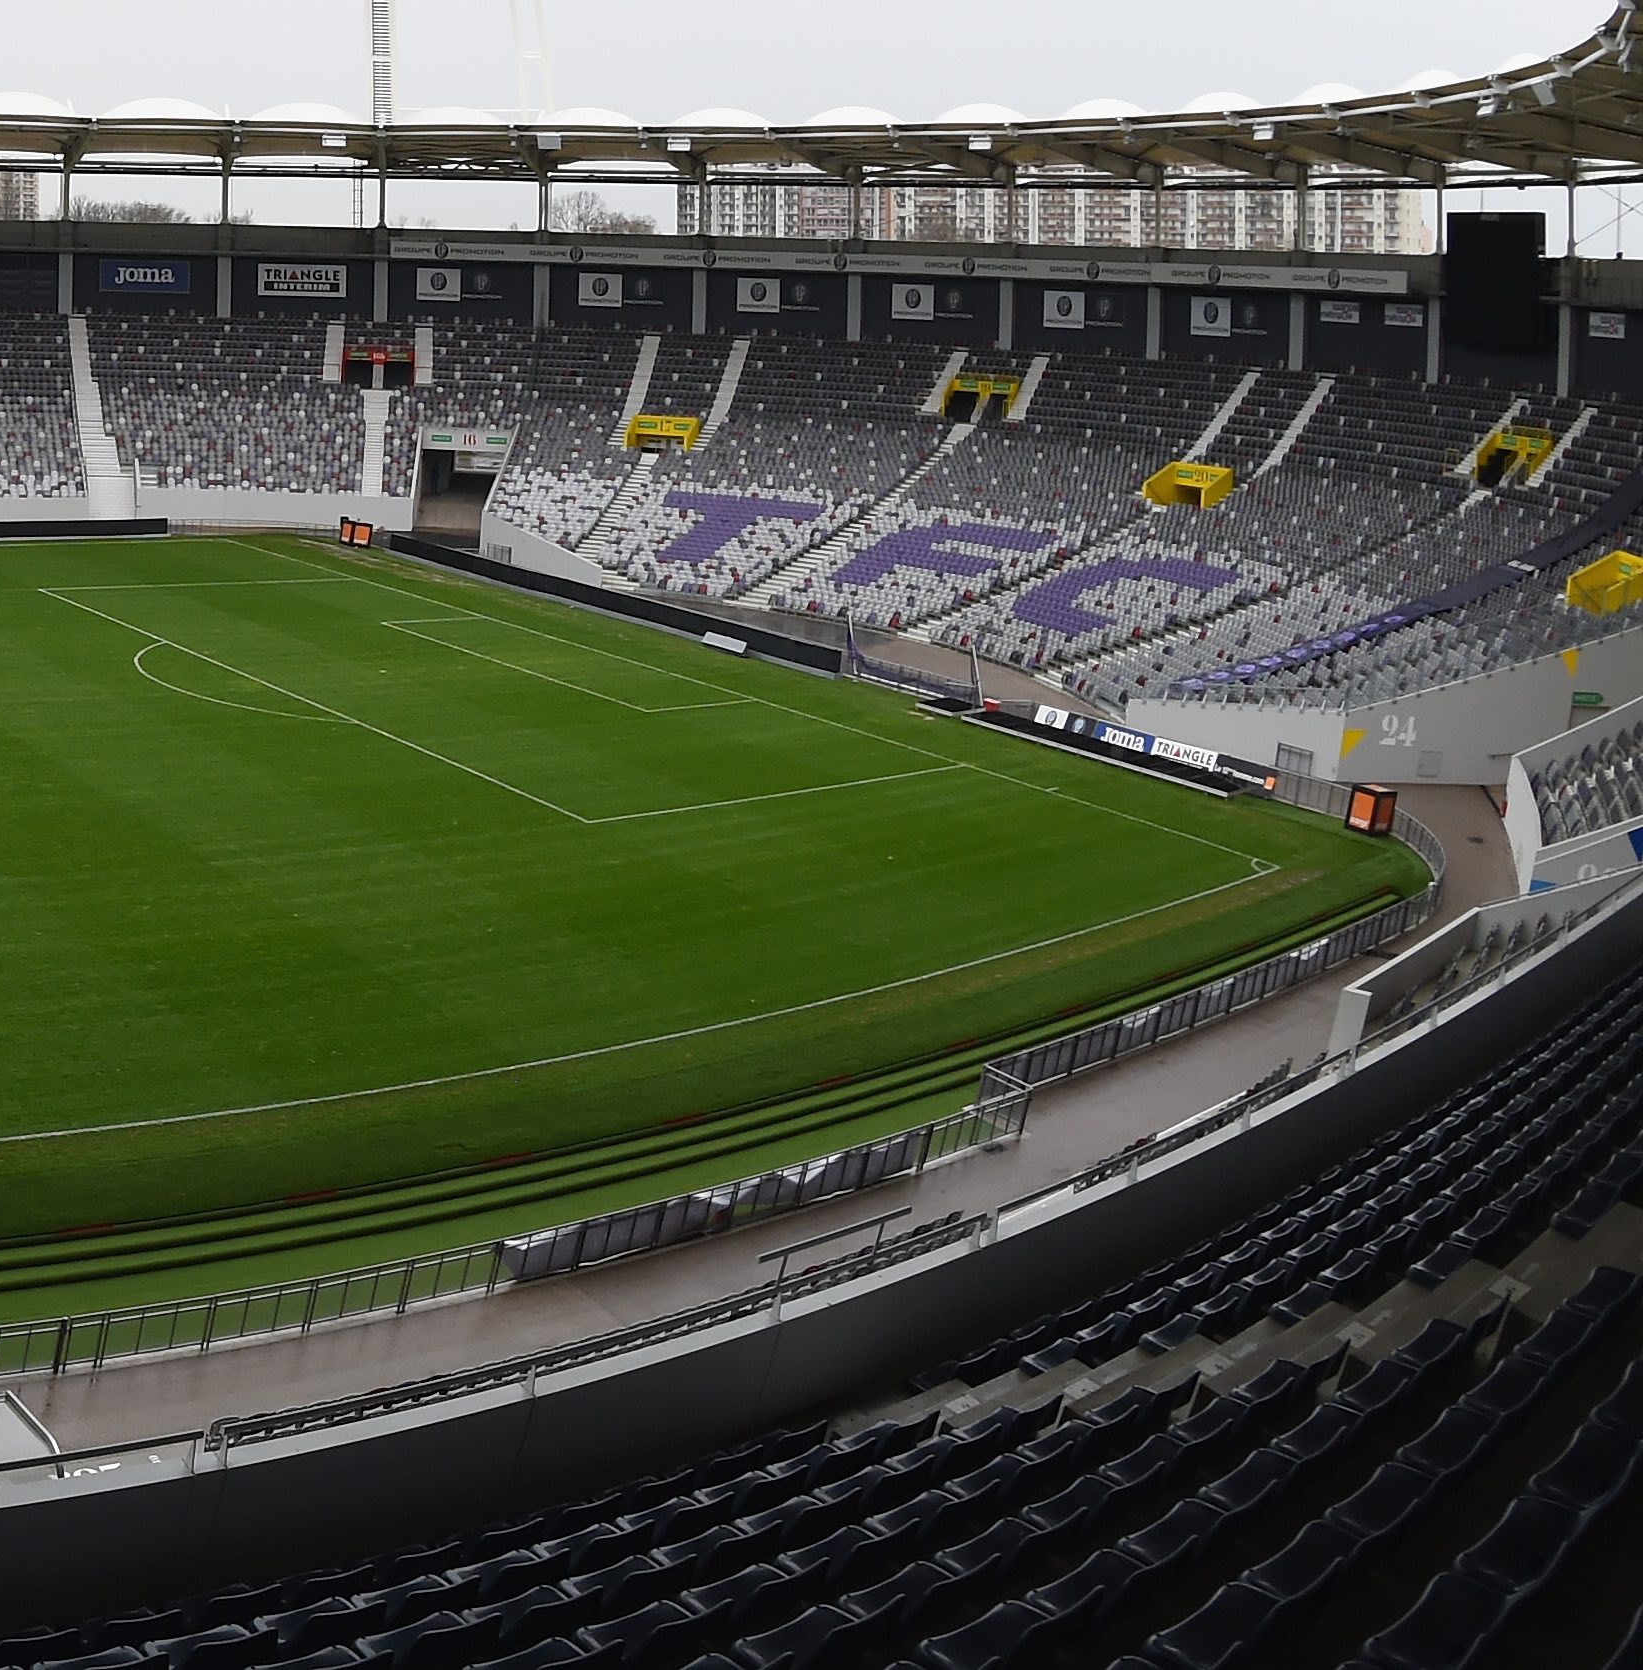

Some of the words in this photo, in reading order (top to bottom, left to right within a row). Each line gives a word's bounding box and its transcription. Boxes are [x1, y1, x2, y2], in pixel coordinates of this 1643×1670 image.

[265, 269, 340, 281] TRIANGLE
[463, 434, 476, 445] 16
[1379, 715, 1416, 747] 24
[1157, 742, 1214, 766] TRIANGLE
